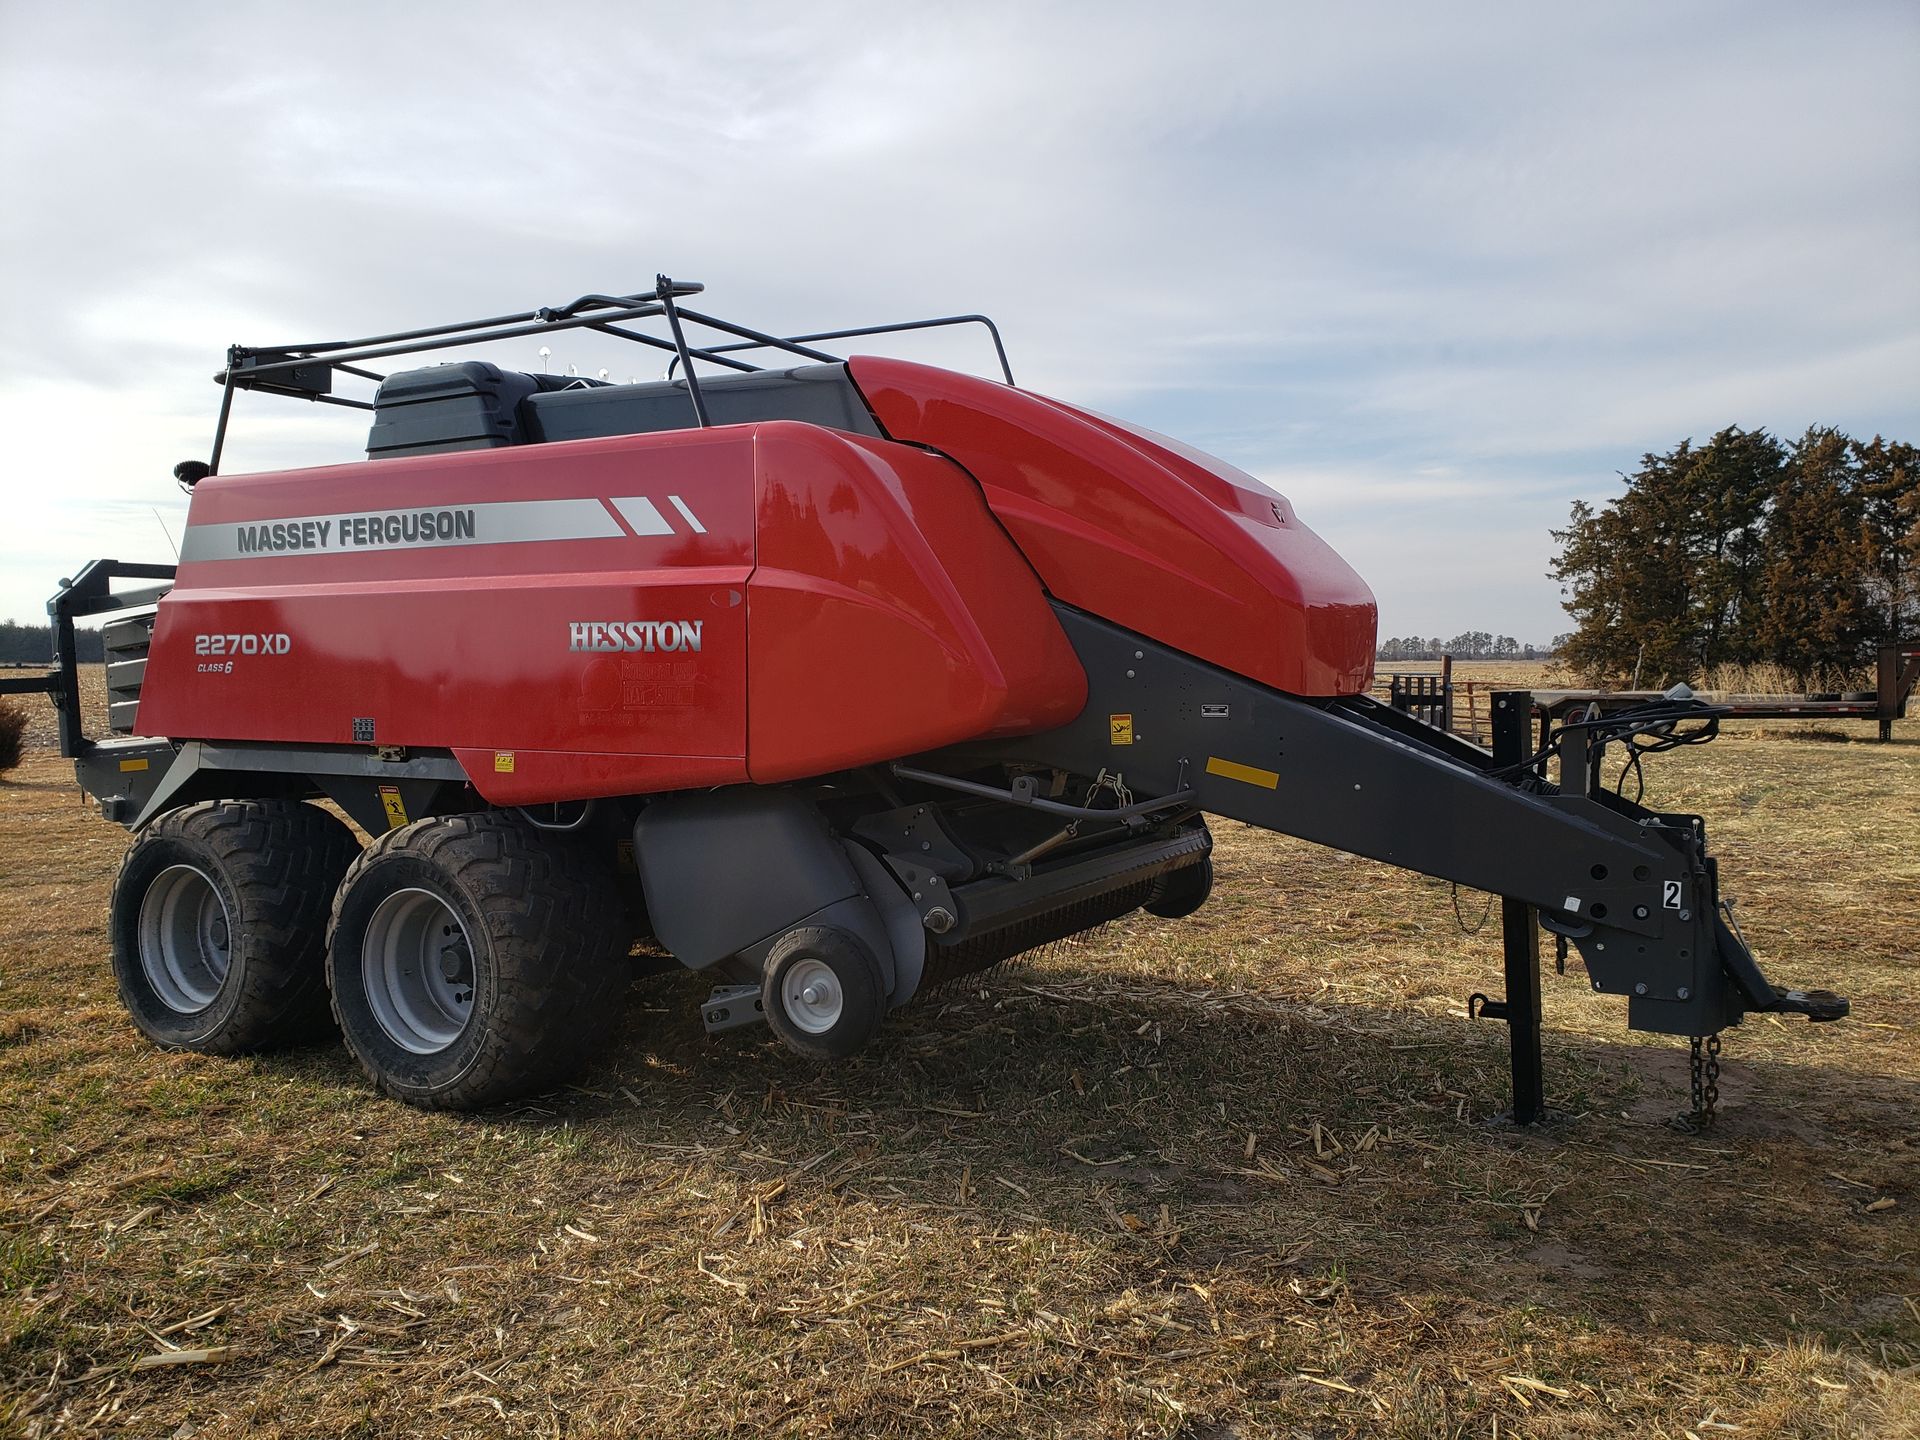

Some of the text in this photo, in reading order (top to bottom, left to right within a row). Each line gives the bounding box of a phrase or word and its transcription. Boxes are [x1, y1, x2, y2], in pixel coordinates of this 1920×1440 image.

[237, 509, 476, 553] MASSEY FERGUSON
[568, 619, 703, 653] HESSTON
[1665, 882, 1680, 908] 2
